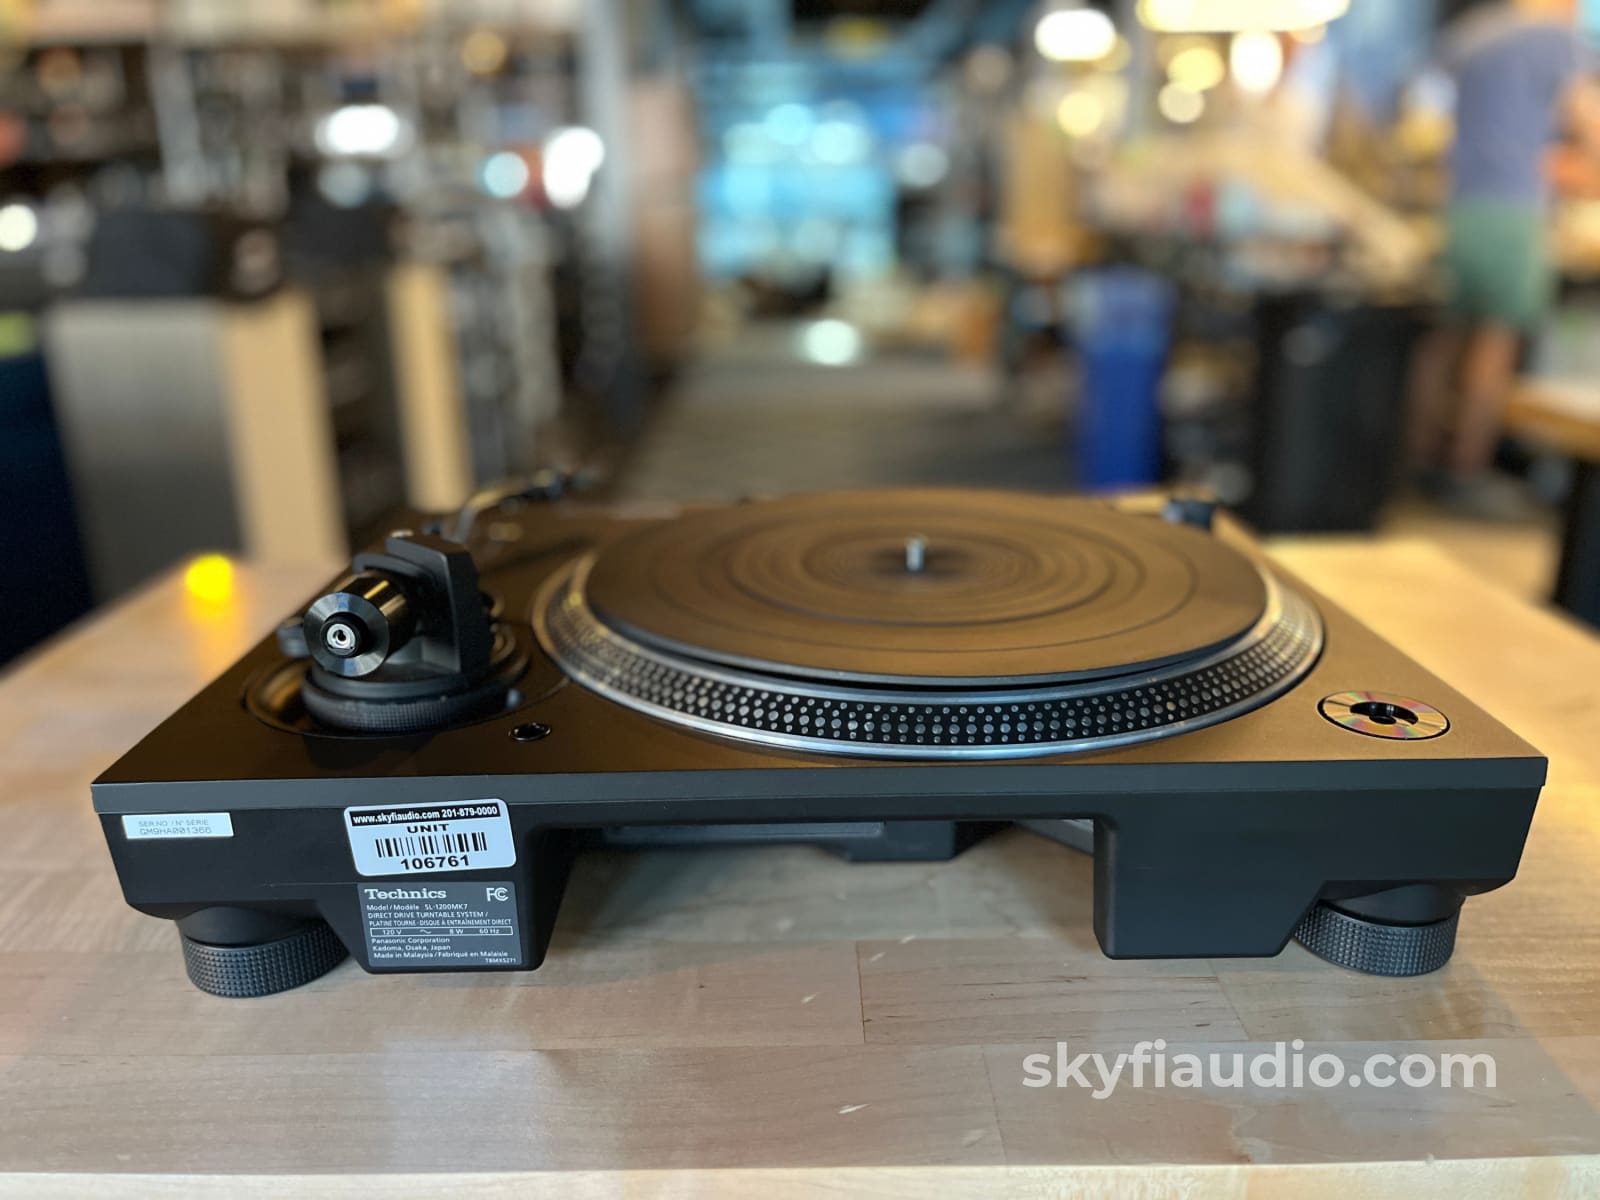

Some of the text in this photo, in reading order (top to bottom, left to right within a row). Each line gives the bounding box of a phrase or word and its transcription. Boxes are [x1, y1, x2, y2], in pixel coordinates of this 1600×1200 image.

[352, 806, 498, 825] www.skyfiaudio.com 201-879-0000
[406, 823, 450, 834] UNIT
[400, 855, 470, 870] 106761
[364, 887, 447, 900] Technics
[403, 951, 434, 959] Malaysia
